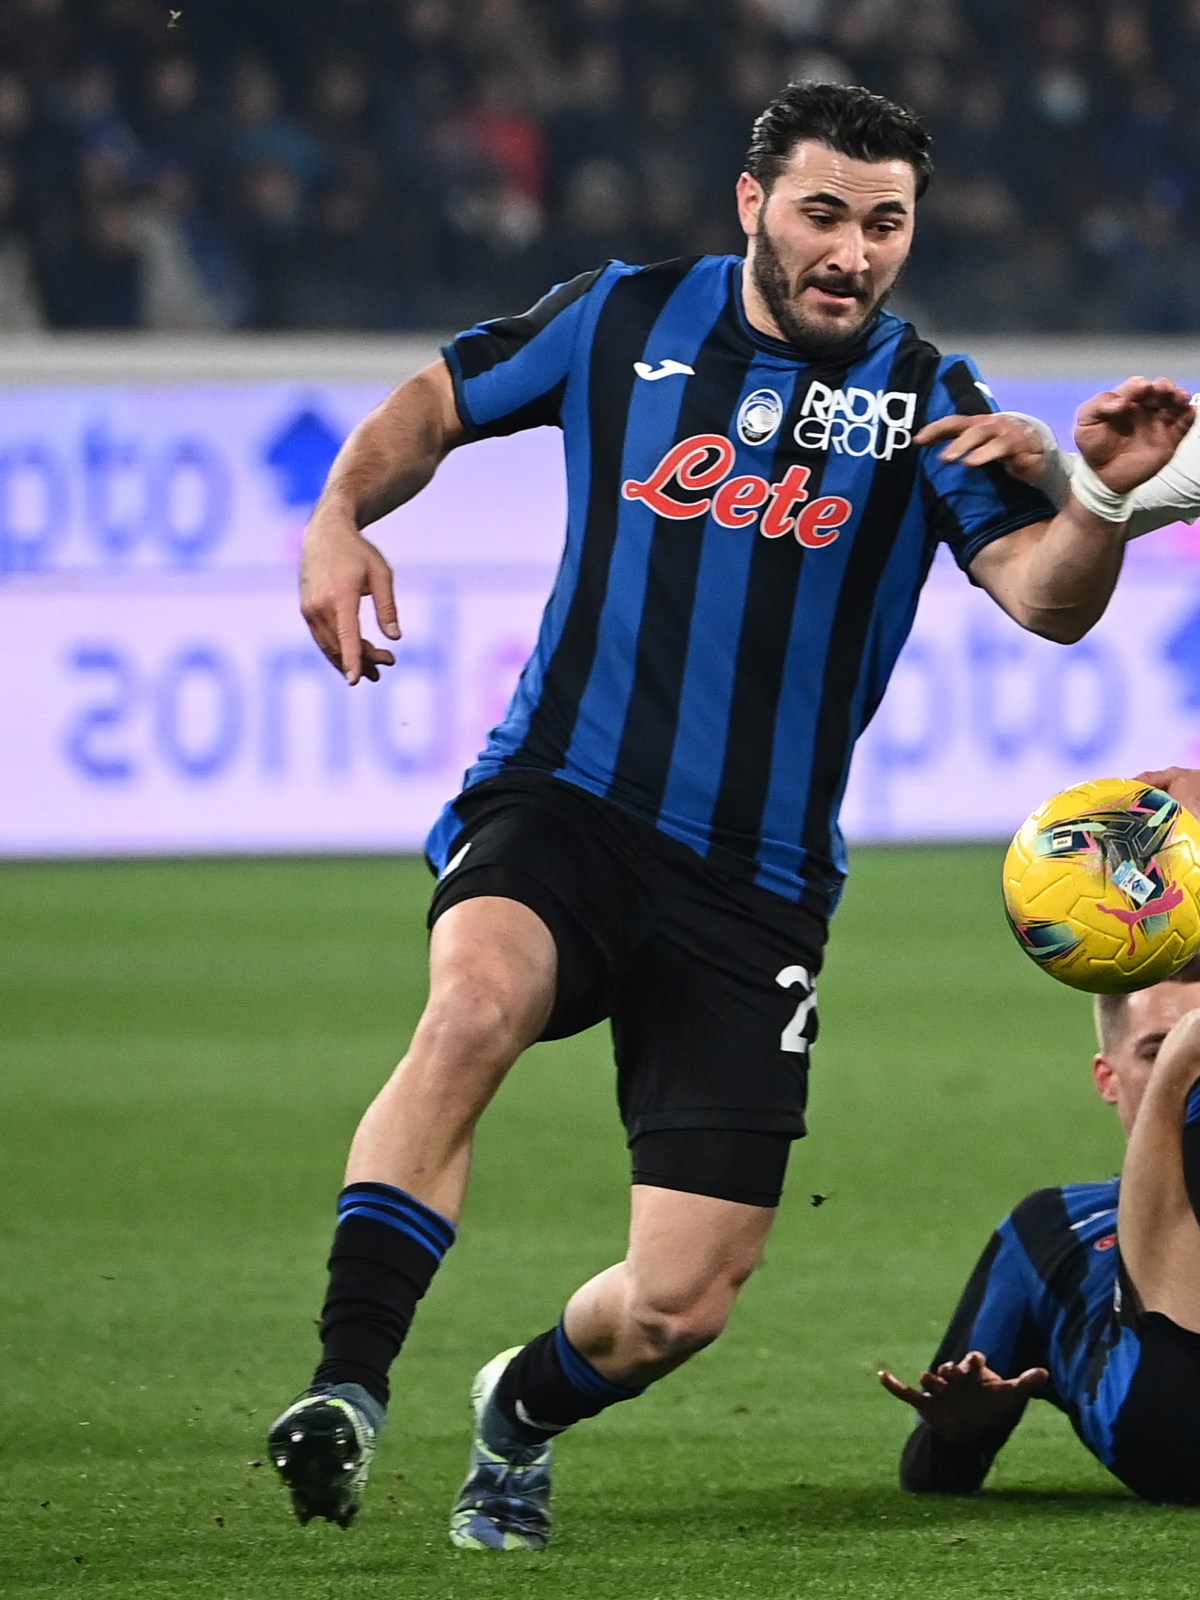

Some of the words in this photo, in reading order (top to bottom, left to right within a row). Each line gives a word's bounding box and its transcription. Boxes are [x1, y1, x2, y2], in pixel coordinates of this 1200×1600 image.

[800, 380, 918, 430] RADICI
[793, 417, 912, 461] GROUP
[621, 433, 852, 549] Lete
